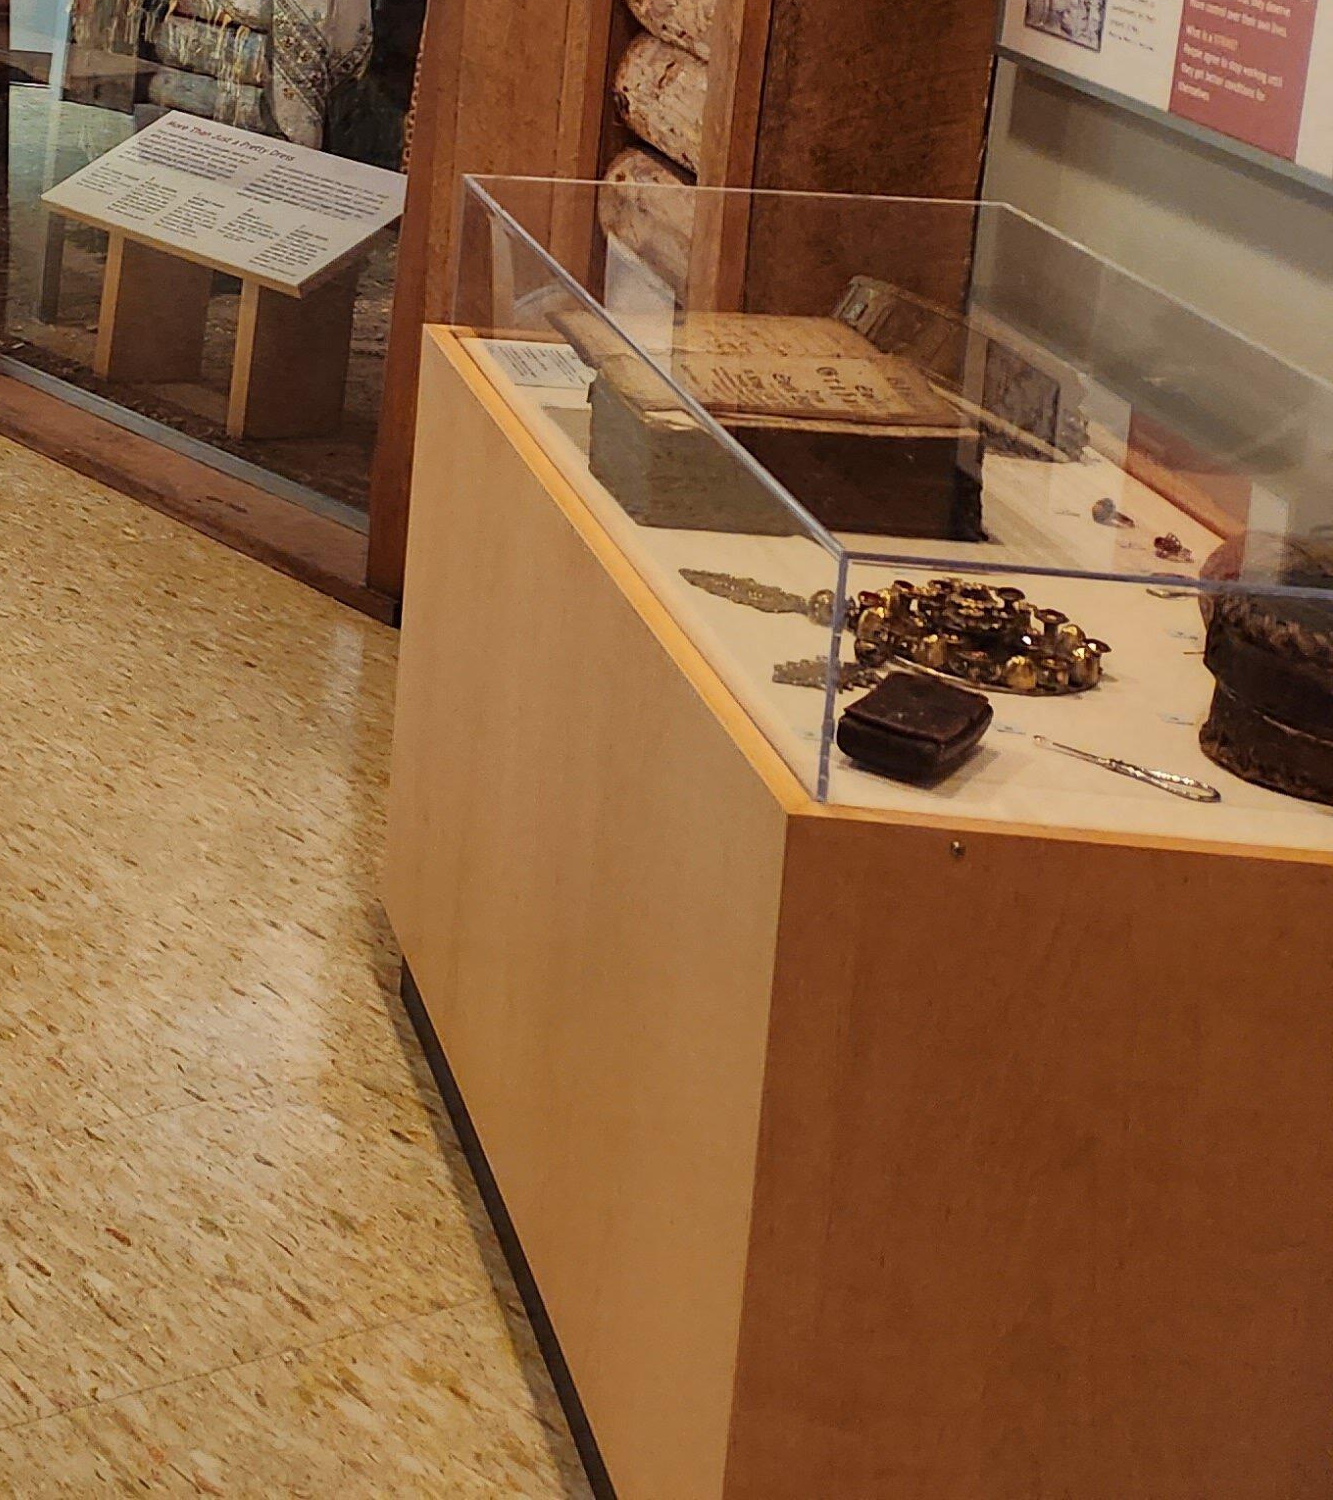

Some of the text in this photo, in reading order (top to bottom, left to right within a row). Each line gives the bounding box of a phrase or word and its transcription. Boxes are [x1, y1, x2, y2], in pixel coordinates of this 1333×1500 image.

[190, 126, 212, 137] Than
[211, 134, 232, 144] Just
[239, 141, 267, 155] Pretty
[269, 149, 295, 162] Dress
